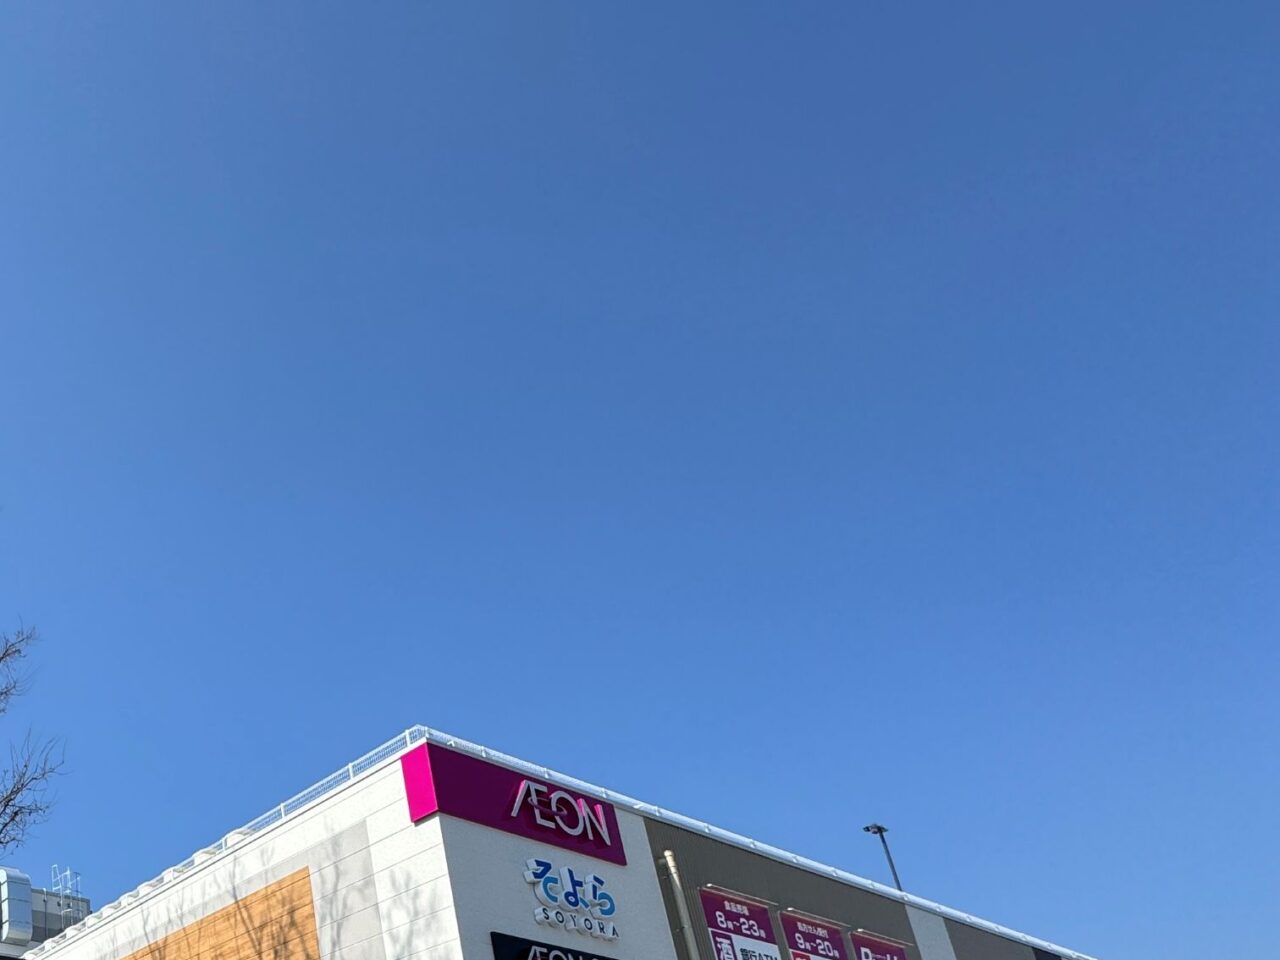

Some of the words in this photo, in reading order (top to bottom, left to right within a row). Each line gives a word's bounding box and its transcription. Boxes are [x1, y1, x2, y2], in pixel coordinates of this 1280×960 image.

[526, 858, 616, 916] そよら
[542, 908, 619, 937] SOYORA
